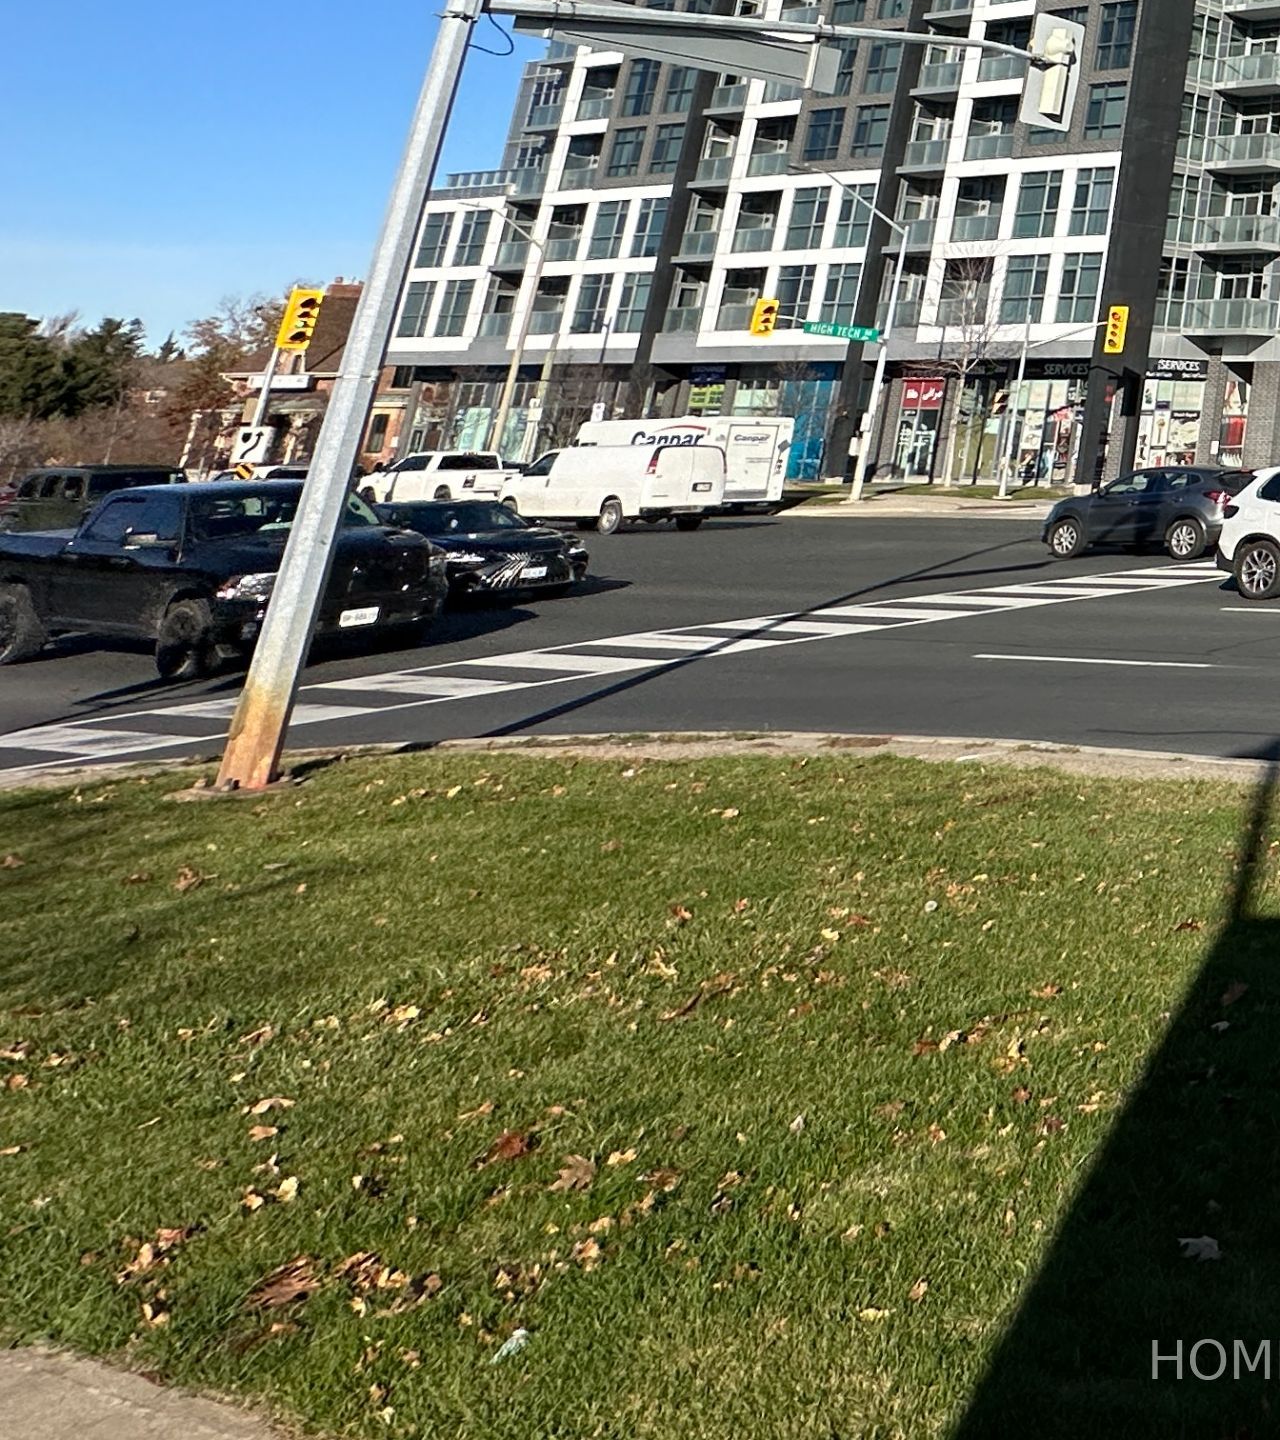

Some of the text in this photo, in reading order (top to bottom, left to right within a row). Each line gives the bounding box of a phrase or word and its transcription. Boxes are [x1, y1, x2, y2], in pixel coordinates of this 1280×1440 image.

[810, 323, 834, 335] HIGH
[837, 326, 861, 338] TECH
[1043, 363, 1089, 375] SERVICES
[1157, 359, 1200, 371] SERVICES
